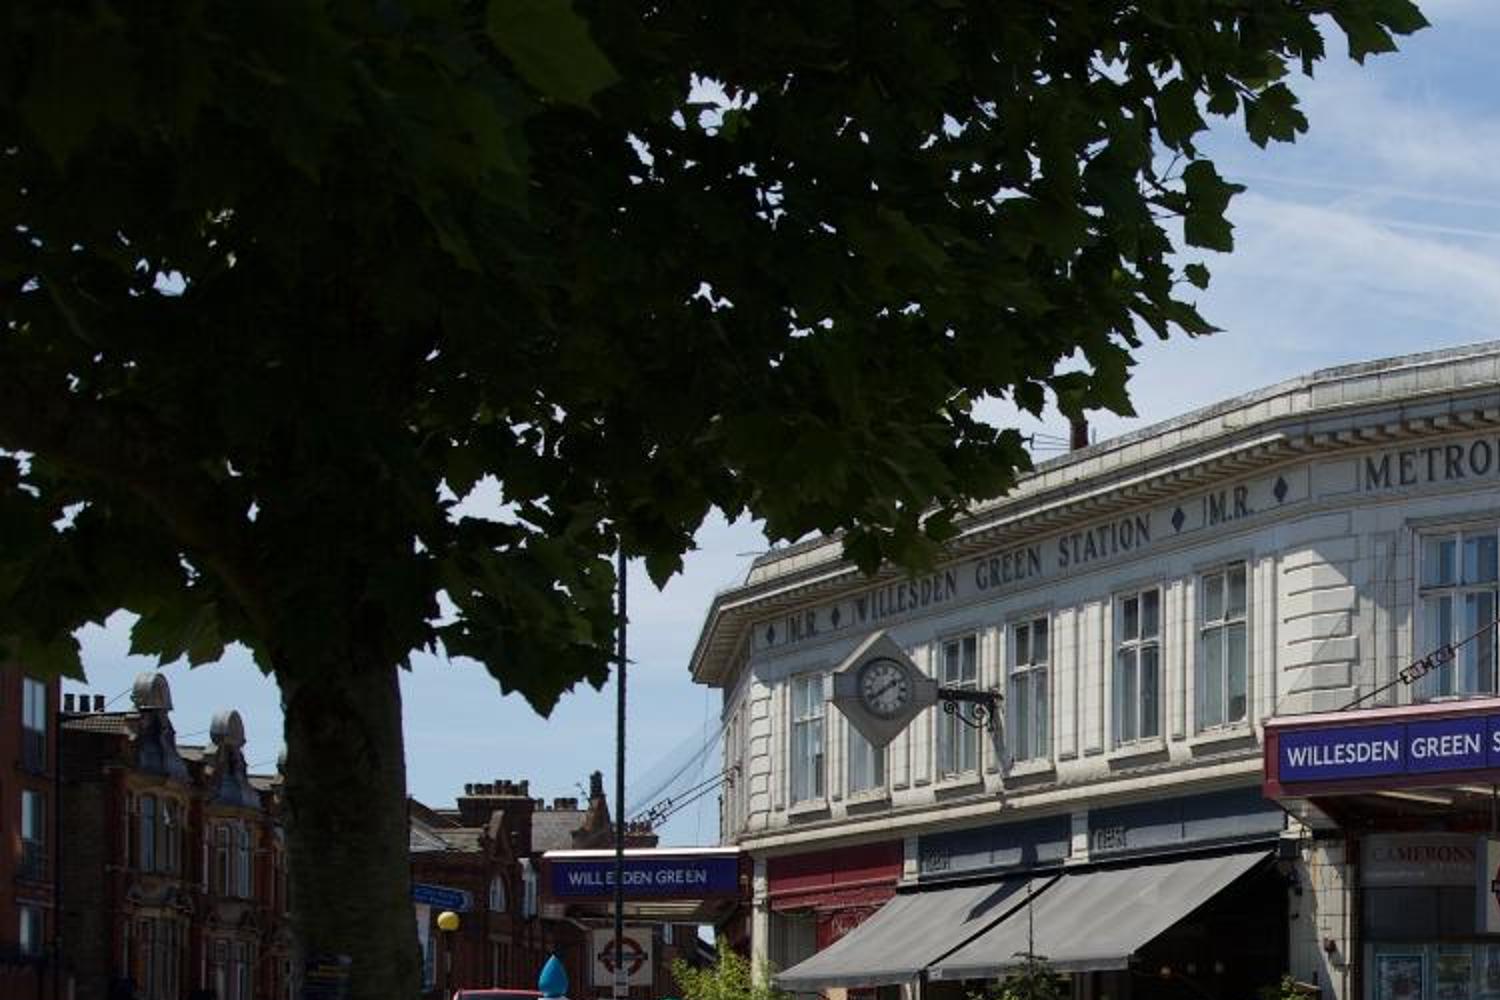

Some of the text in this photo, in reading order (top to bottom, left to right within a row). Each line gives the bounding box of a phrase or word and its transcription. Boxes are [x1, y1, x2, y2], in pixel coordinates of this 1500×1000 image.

[853, 568, 958, 621] WILLESDEN
[975, 545, 1042, 591] GREEN
[1058, 512, 1152, 569] STATION
[1208, 485, 1255, 527] M.R.
[1287, 740, 1400, 768] WILLESDEN
[1410, 733, 1482, 759] GREEN
[567, 868, 708, 886] WILLEDEN GREEN
